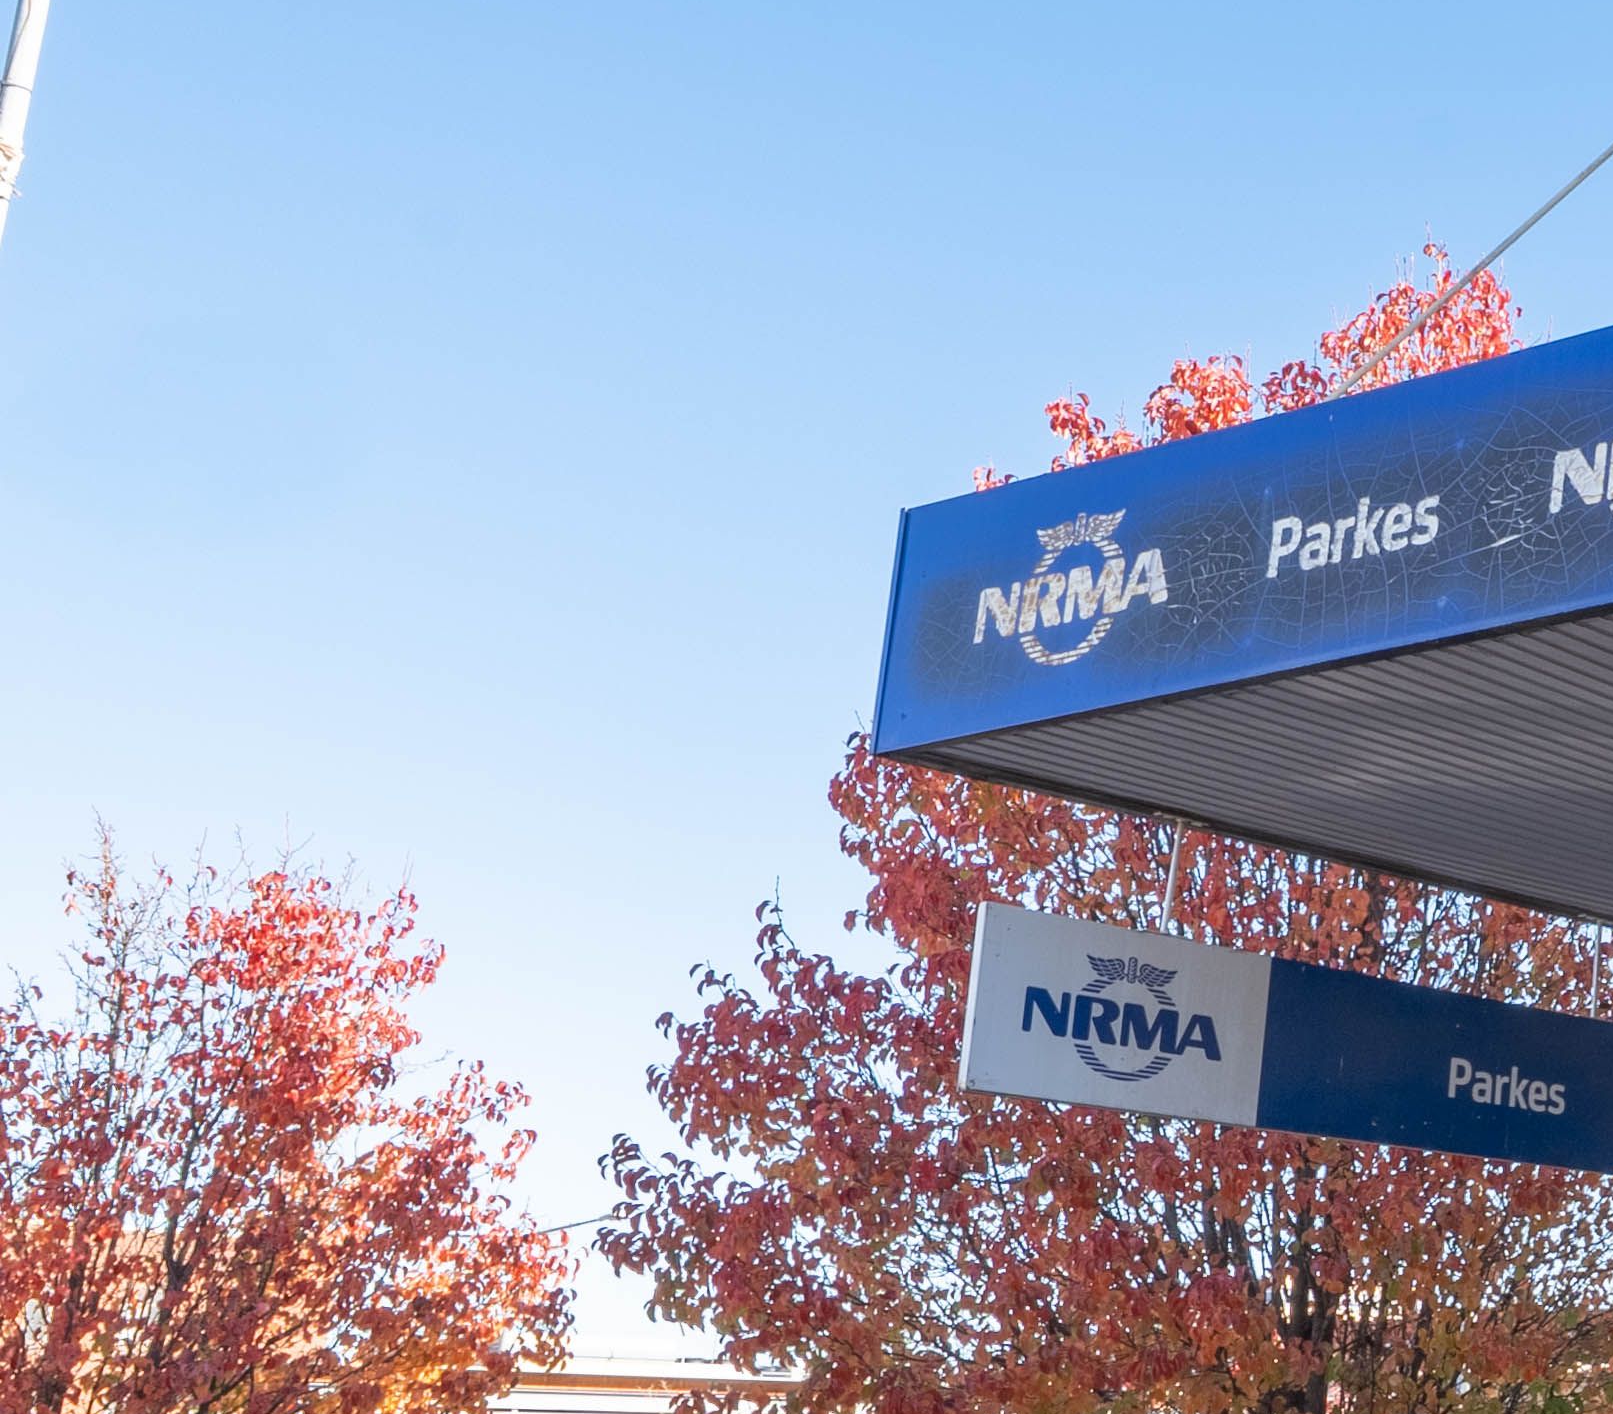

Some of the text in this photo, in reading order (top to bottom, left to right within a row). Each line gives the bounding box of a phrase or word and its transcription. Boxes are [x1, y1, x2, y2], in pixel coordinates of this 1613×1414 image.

[973, 547, 1168, 645] NRMA
[1266, 495, 1441, 579] Parkes
[1022, 986, 1566, 1116] NRMA Parkes
